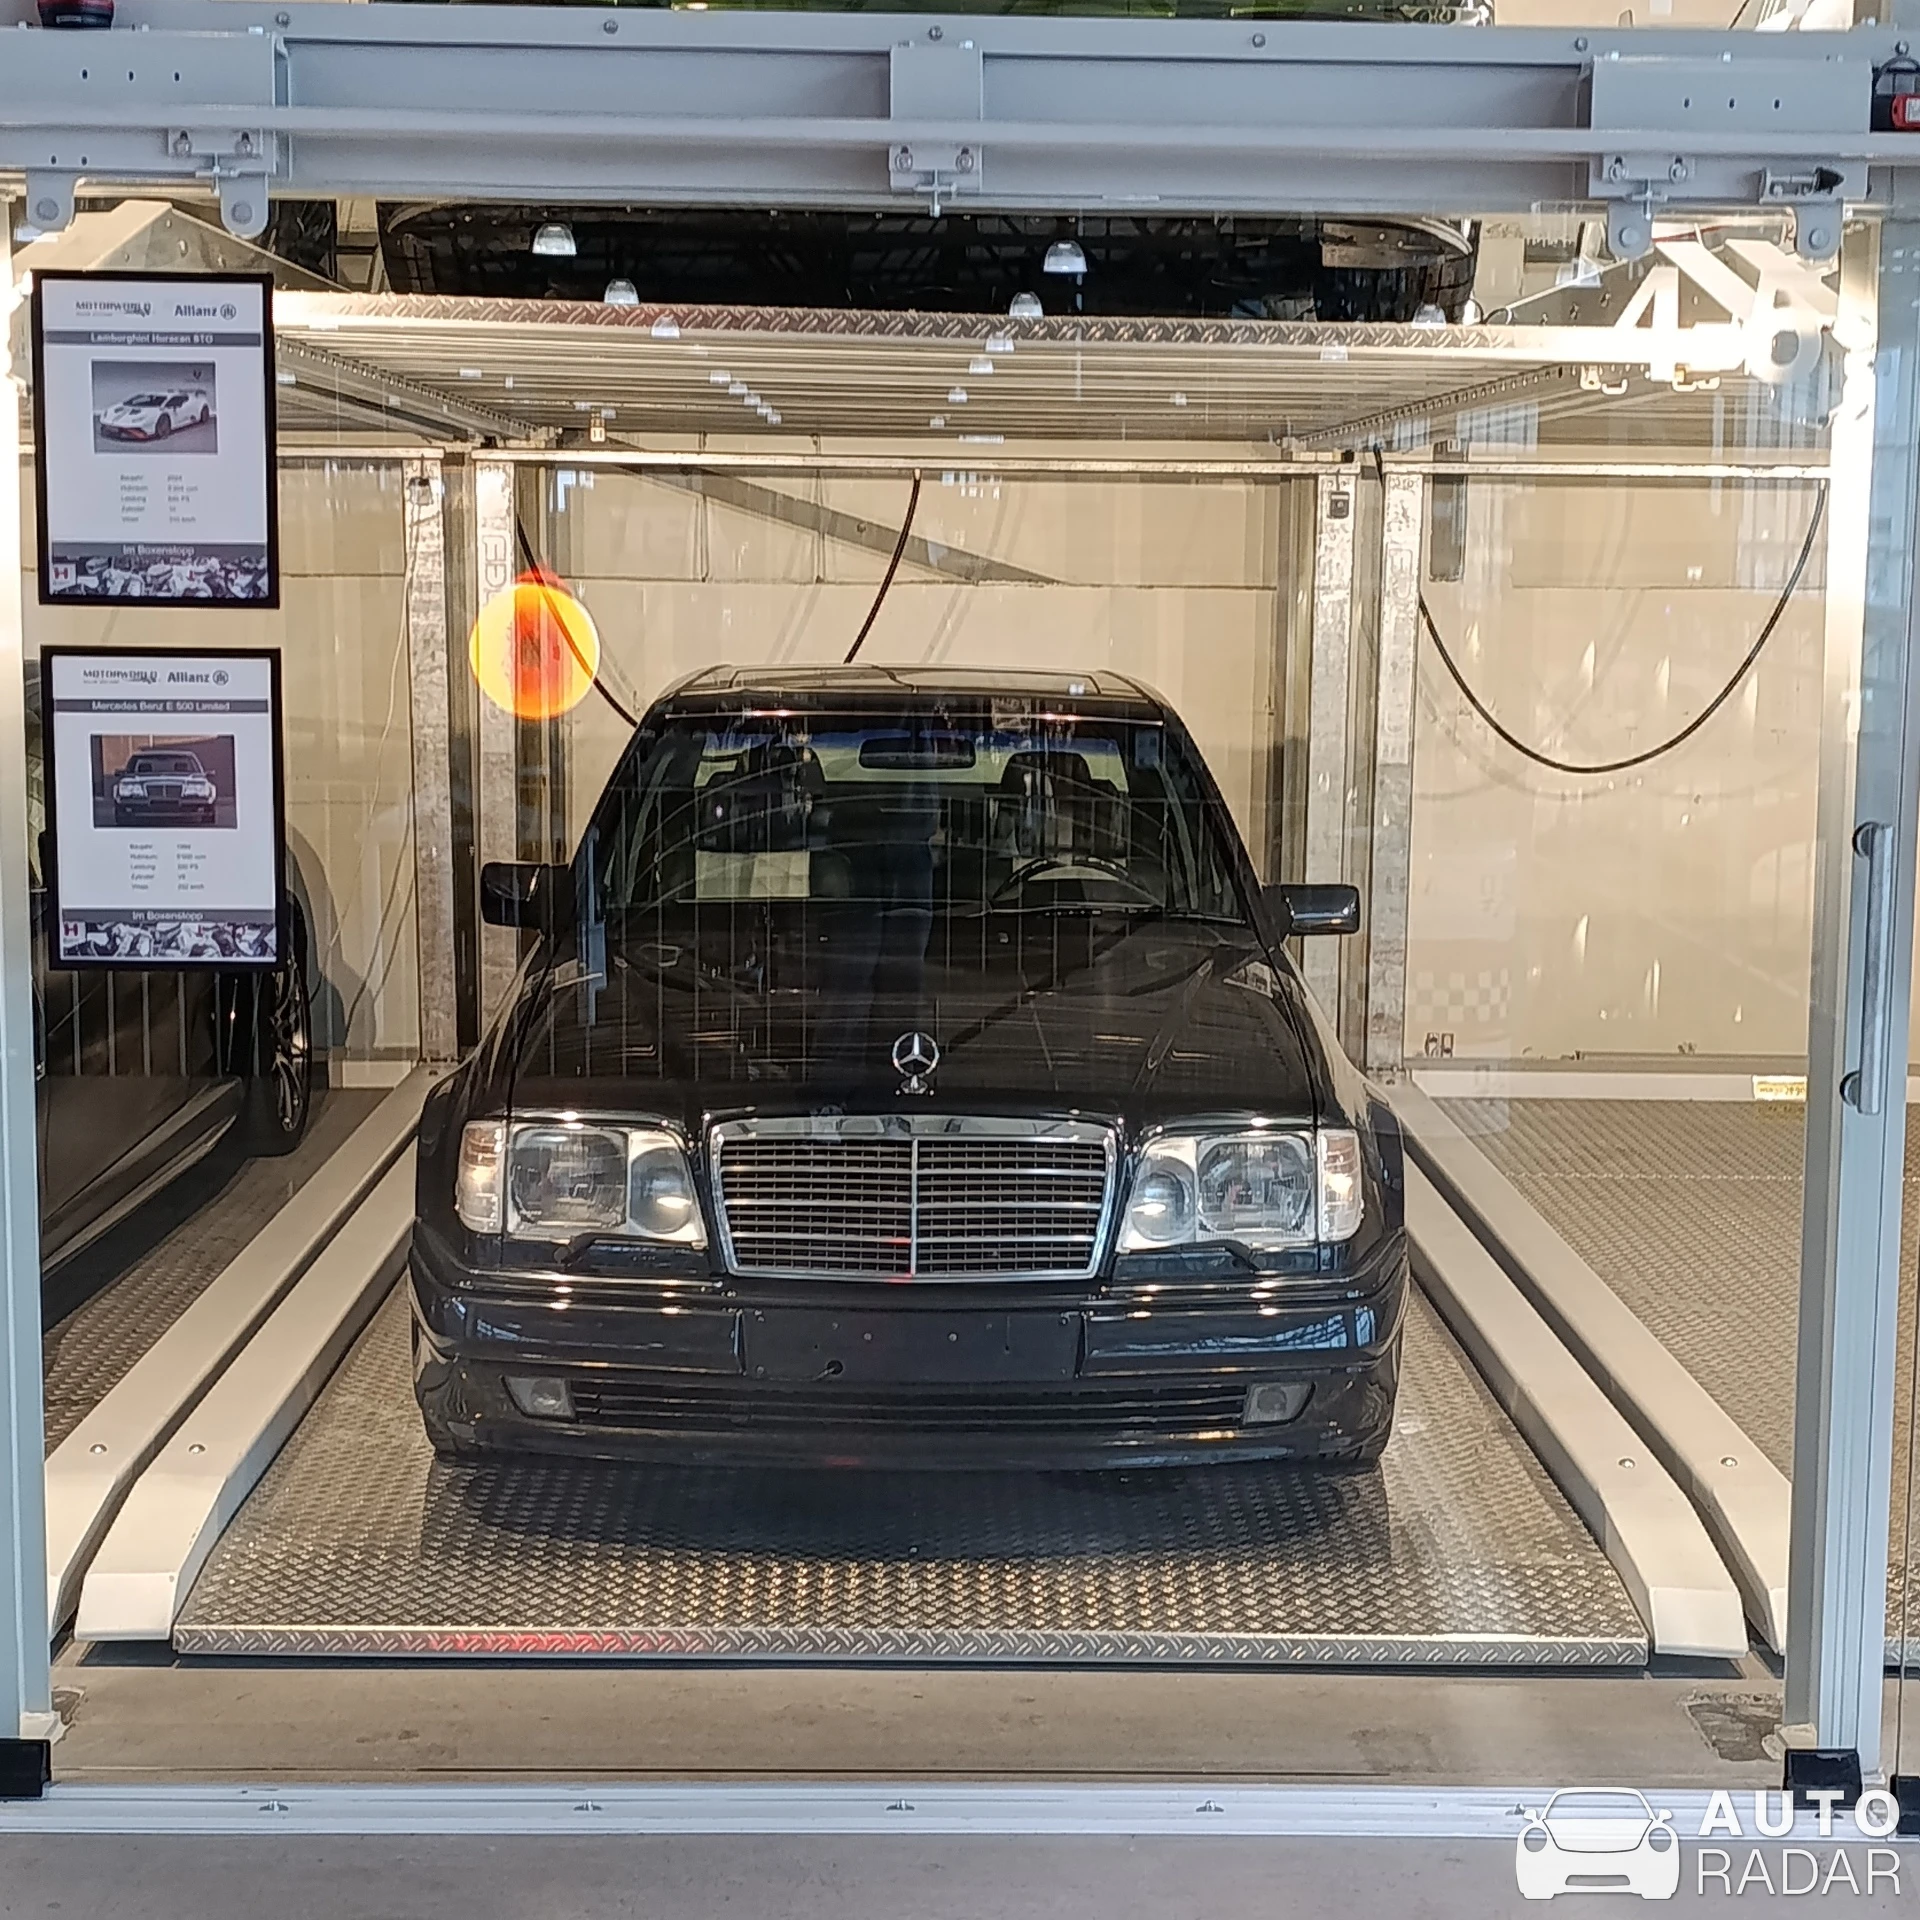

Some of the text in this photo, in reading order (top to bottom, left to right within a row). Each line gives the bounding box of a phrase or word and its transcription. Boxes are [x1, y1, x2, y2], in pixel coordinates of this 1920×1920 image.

[174, 304, 217, 317] Allianz
[123, 545, 136, 555] Im
[167, 672, 210, 684] Allianz
[92, 701, 230, 712] Mercedes Benz E 500 Limited
[132, 911, 146, 921] Im
